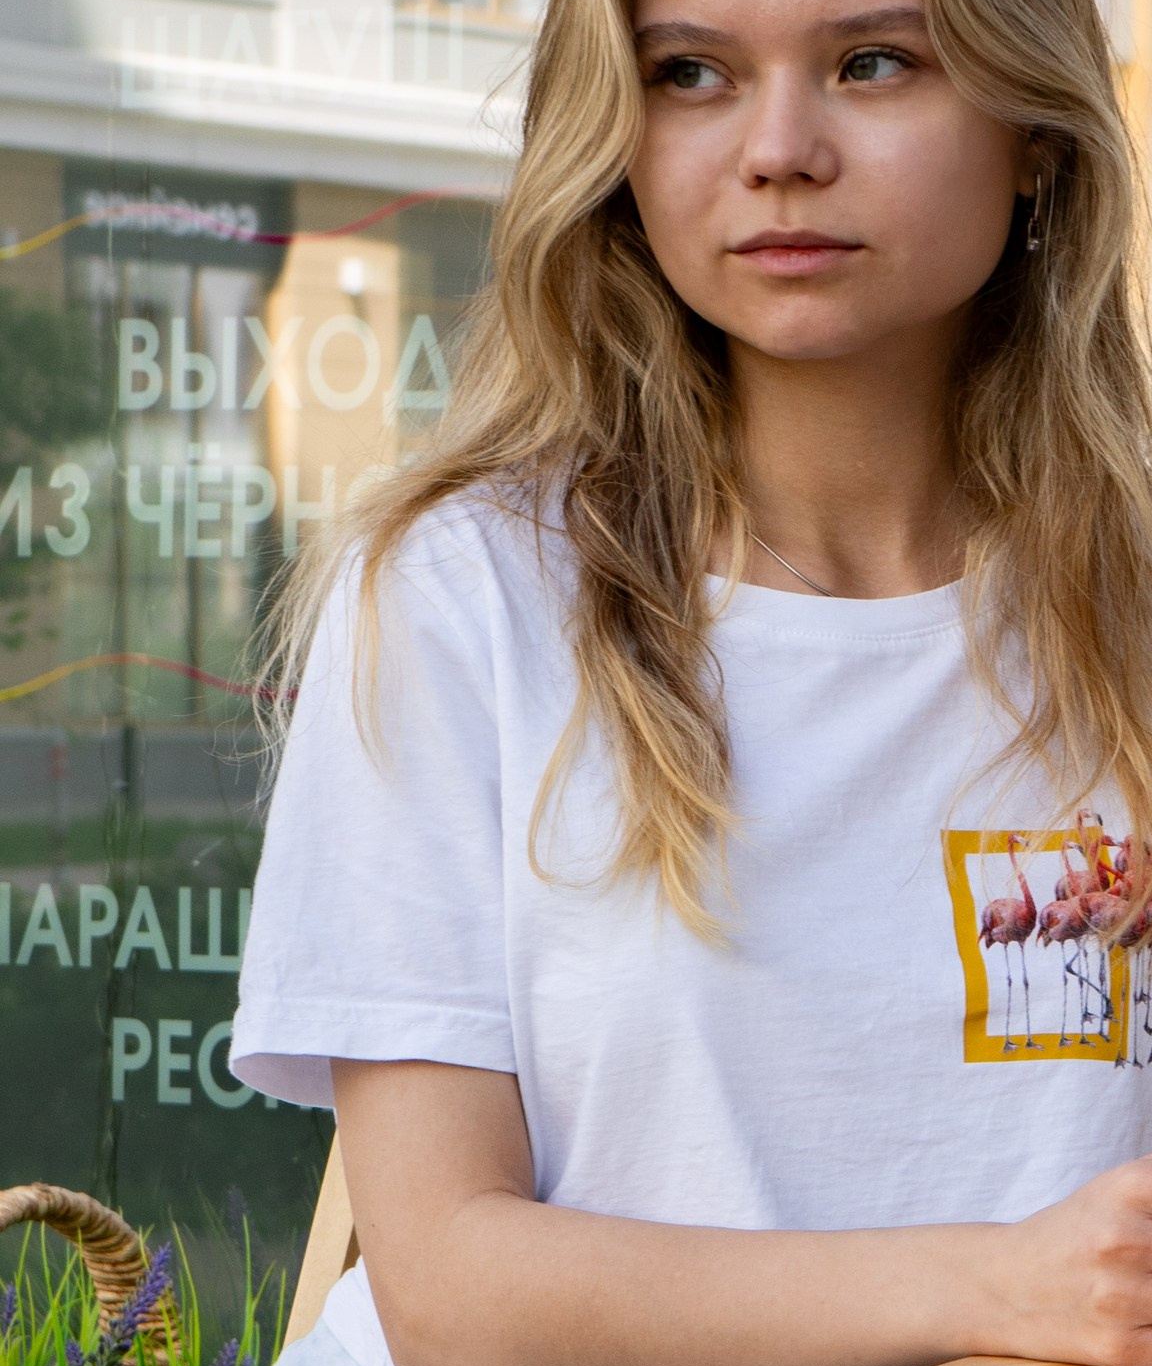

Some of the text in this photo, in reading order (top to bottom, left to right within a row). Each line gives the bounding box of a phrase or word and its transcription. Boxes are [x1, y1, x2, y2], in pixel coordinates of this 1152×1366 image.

[120, 2, 465, 111] ШАТУШ
[117, 313, 453, 427] ВЫХОД
[111, 1016, 334, 1109] РЕС
